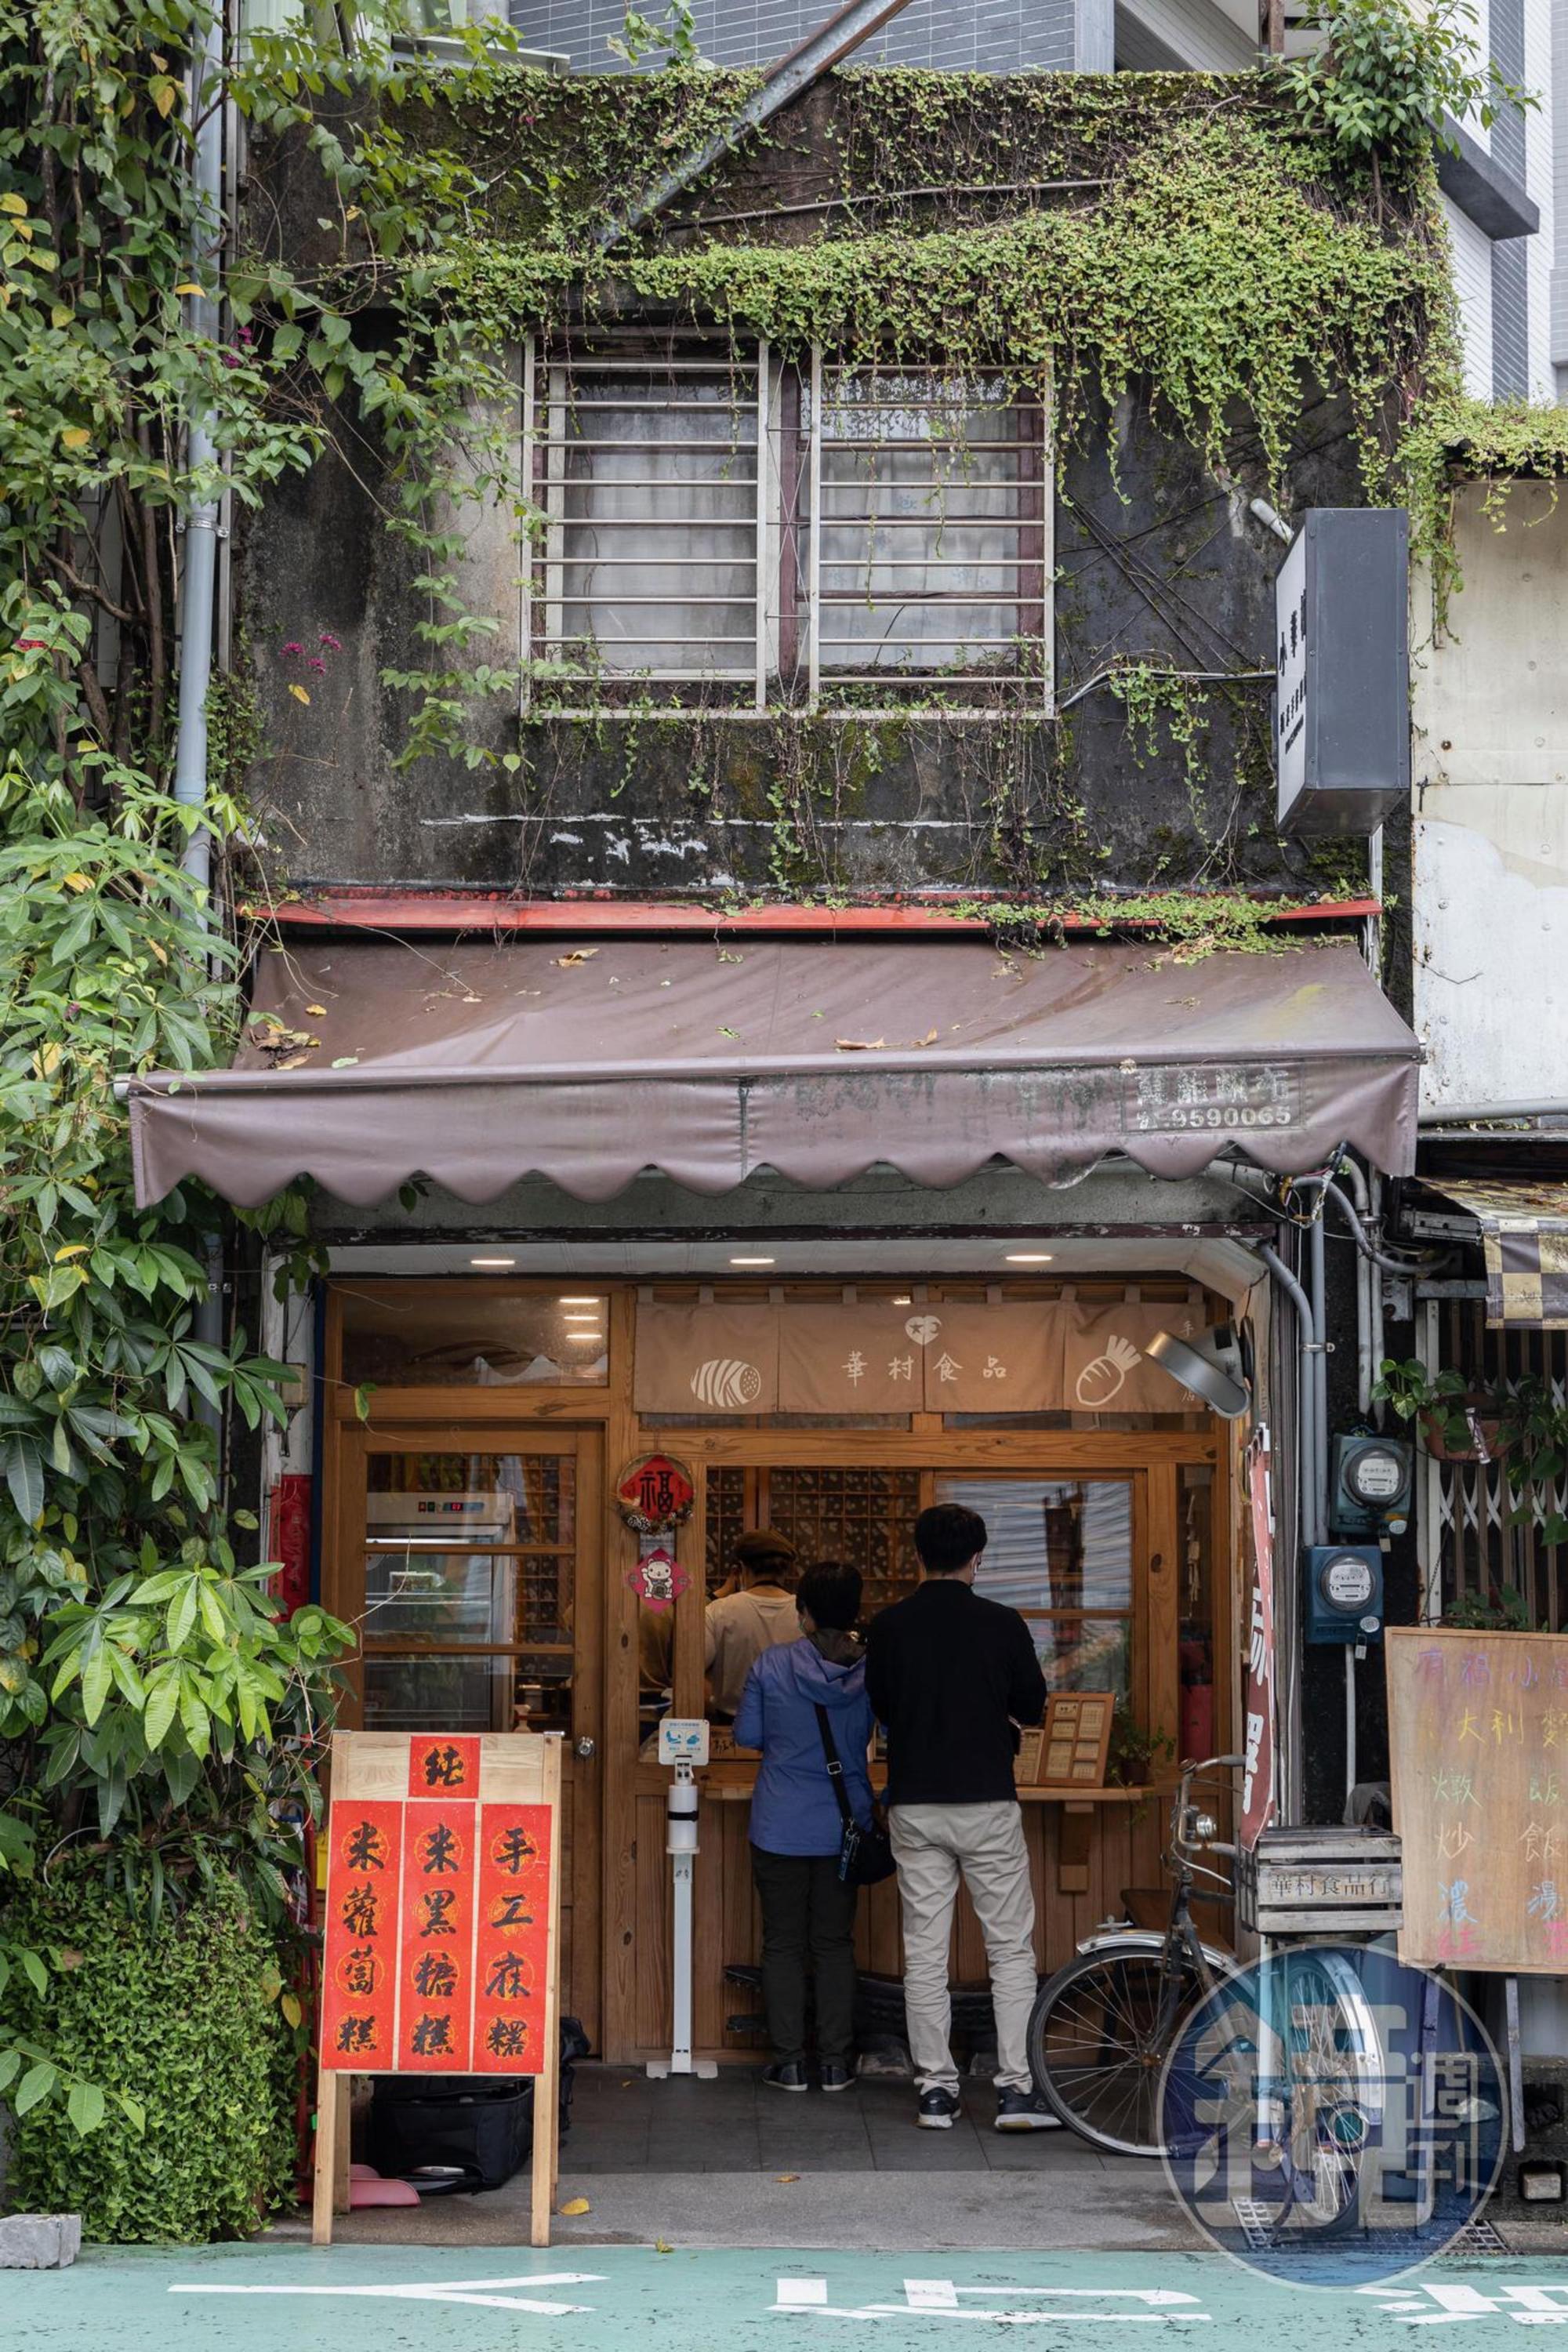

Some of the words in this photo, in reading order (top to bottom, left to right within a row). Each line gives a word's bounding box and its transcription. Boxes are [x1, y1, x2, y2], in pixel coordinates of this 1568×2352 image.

[842, 1350, 1007, 1386] 華村食品
[639, 1470, 674, 1514] 福
[1436, 1820, 1565, 1862] 炒飯
[1271, 1874, 1391, 1897] 華村食品行
[412, 1823, 459, 2056] 米黑糖糕
